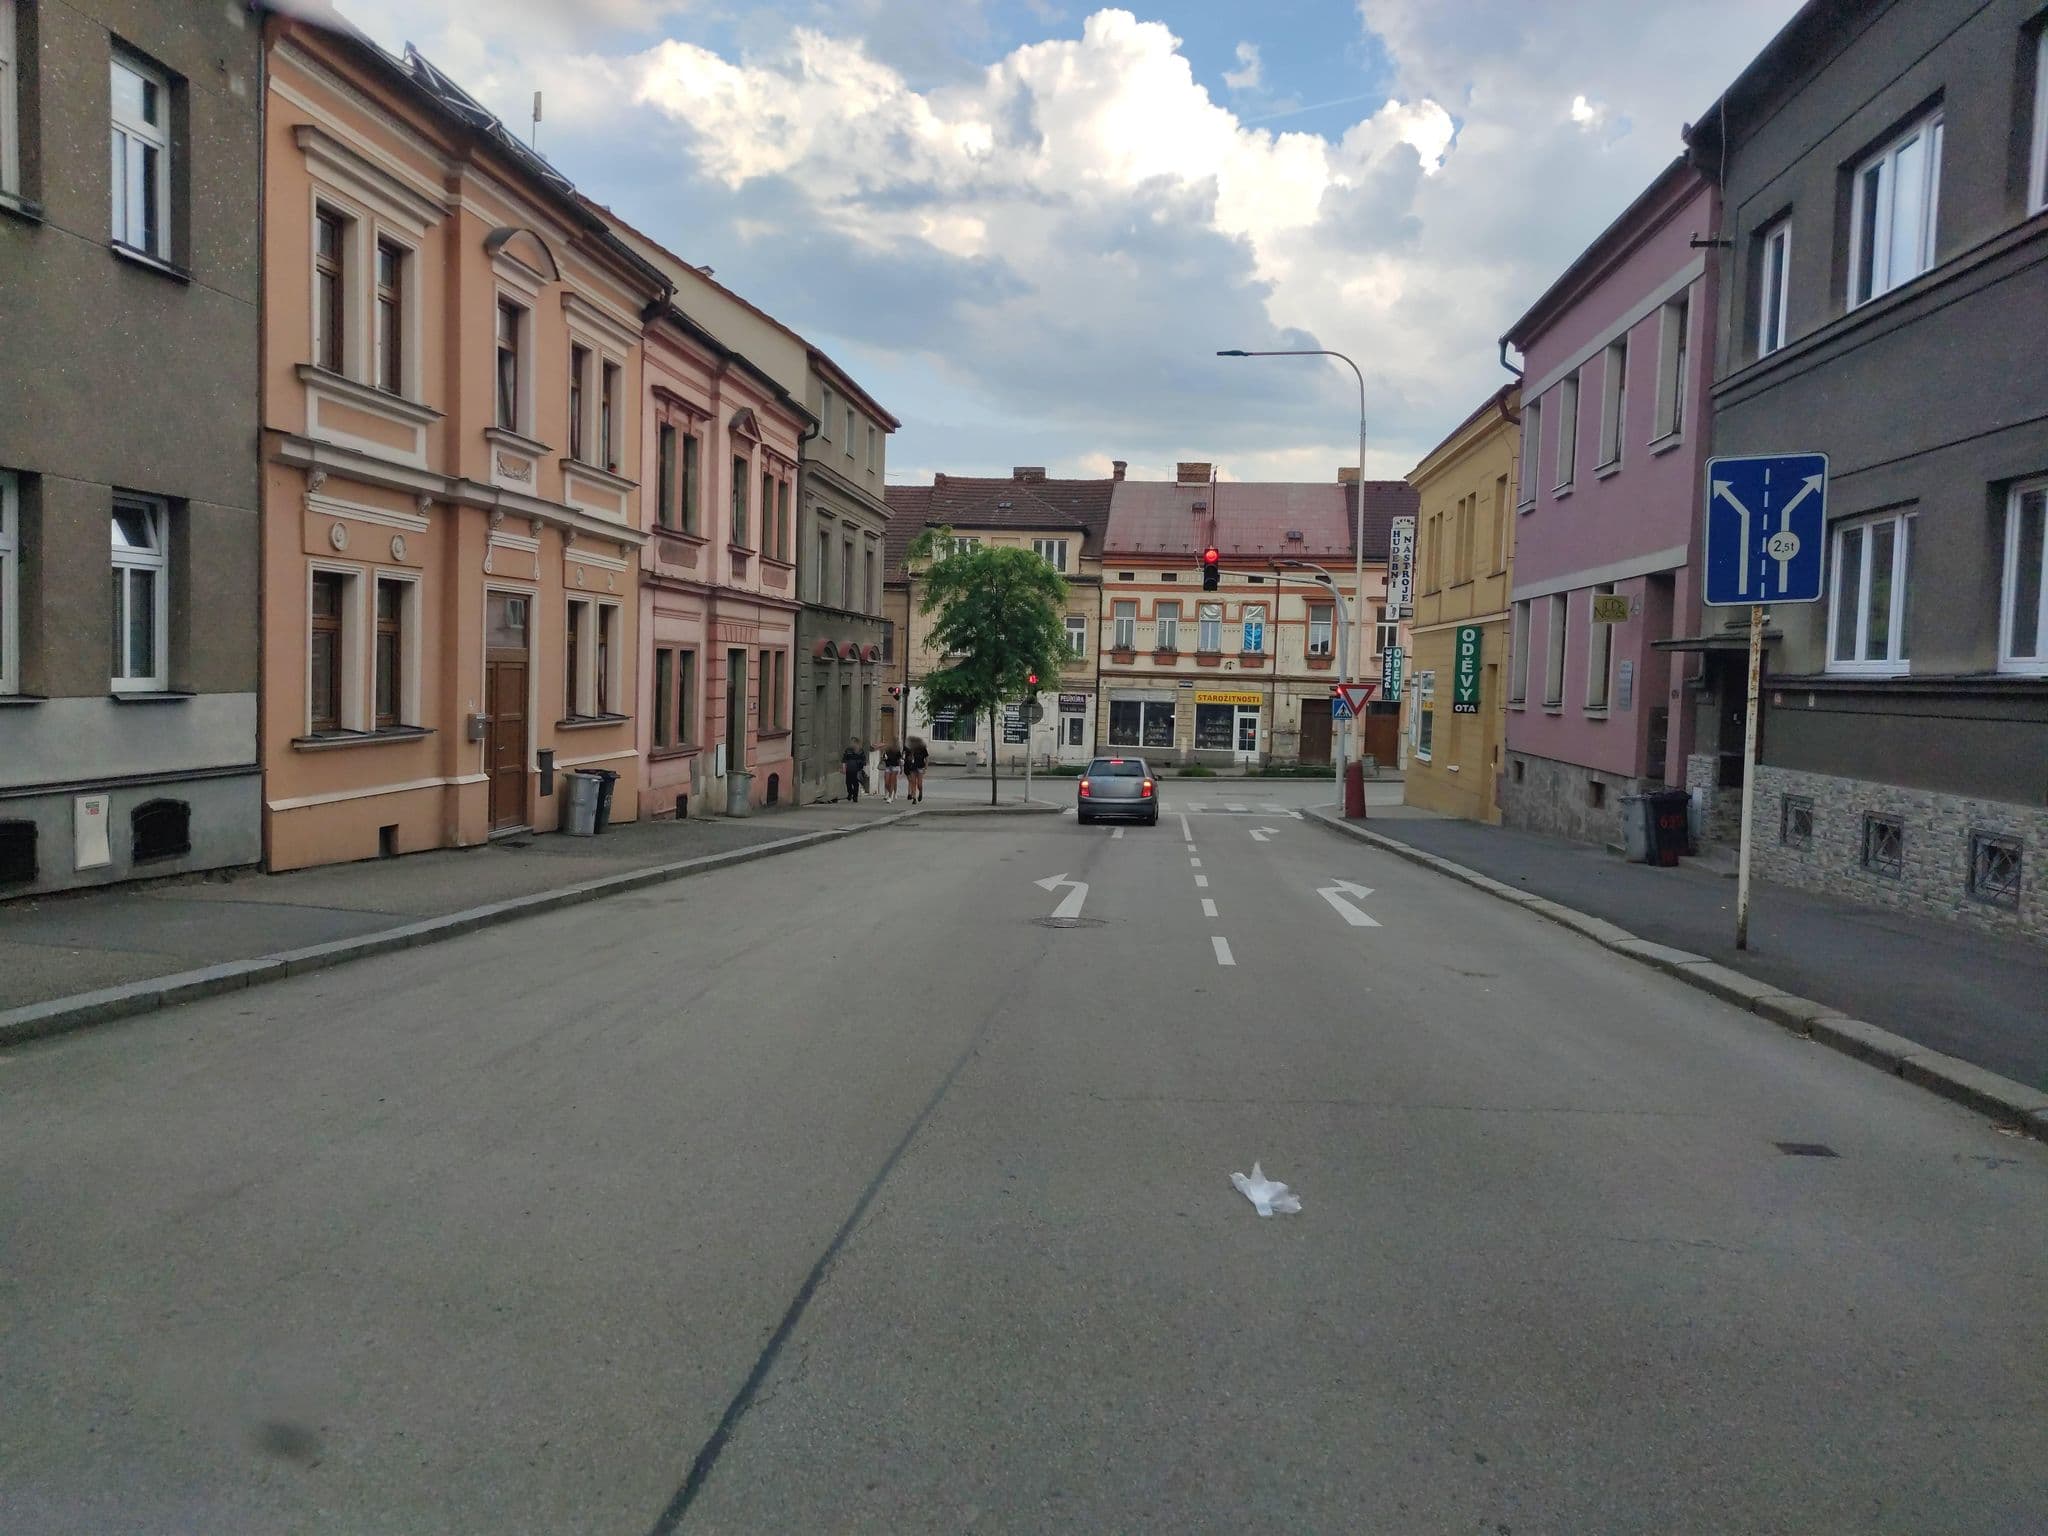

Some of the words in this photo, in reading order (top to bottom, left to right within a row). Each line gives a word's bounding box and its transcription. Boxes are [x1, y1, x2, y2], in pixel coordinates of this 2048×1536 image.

[1391, 530, 1401, 589] HUDEBNÍ
[1392, 648, 1401, 700] ODĚVY
[1460, 628, 1476, 701] ODĚVY
[1198, 694, 1260, 703] STAROŽITNOSTI
[1455, 704, 1476, 712] OTA
